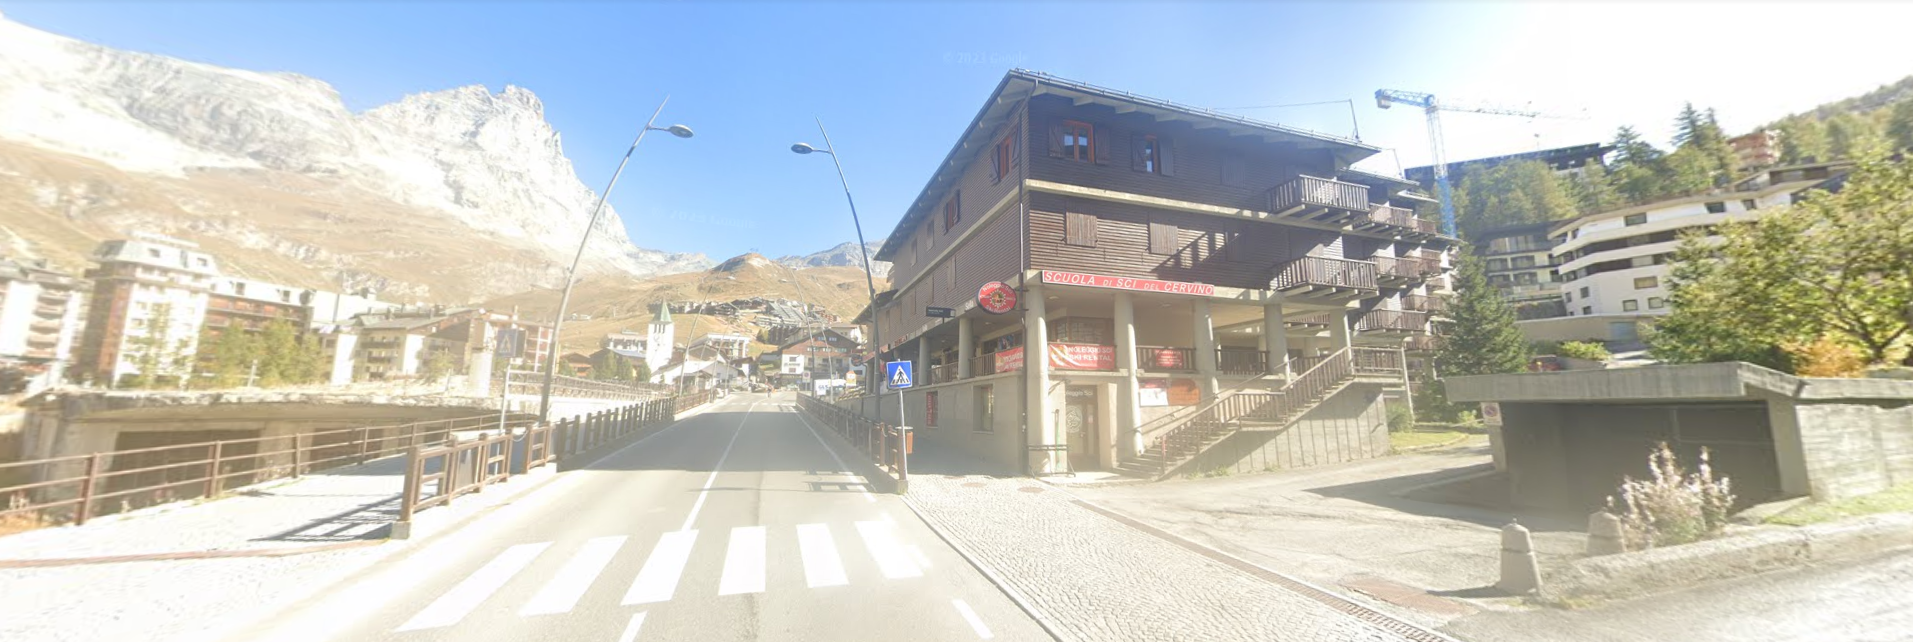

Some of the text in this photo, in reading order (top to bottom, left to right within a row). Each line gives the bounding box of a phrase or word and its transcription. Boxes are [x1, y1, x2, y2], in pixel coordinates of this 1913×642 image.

[1045, 272, 1213, 295] SCUOLA DI SCI DEL CERVINO
[1083, 354, 1112, 362] RENTAL
